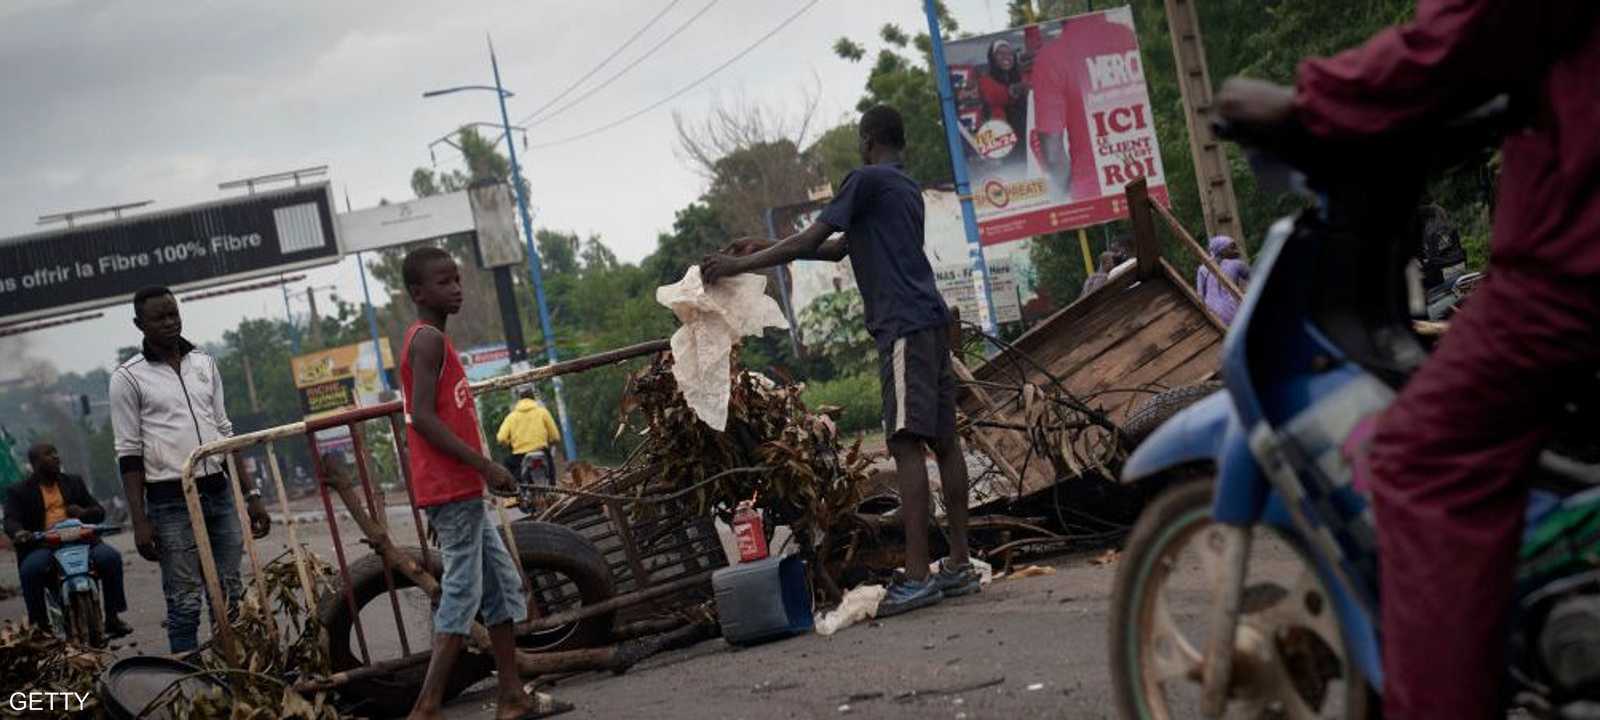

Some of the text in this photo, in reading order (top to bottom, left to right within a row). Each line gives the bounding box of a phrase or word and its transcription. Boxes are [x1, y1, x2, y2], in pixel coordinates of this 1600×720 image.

[1092, 104, 1147, 136] ICI
[1099, 137, 1151, 156] CLIENT
[1103, 157, 1157, 186] ROI
[22, 264, 71, 289] offrir
[75, 261, 95, 279] la
[98, 252, 150, 274] Fibre
[153, 241, 206, 264] 100%
[210, 232, 261, 254] Fibre
